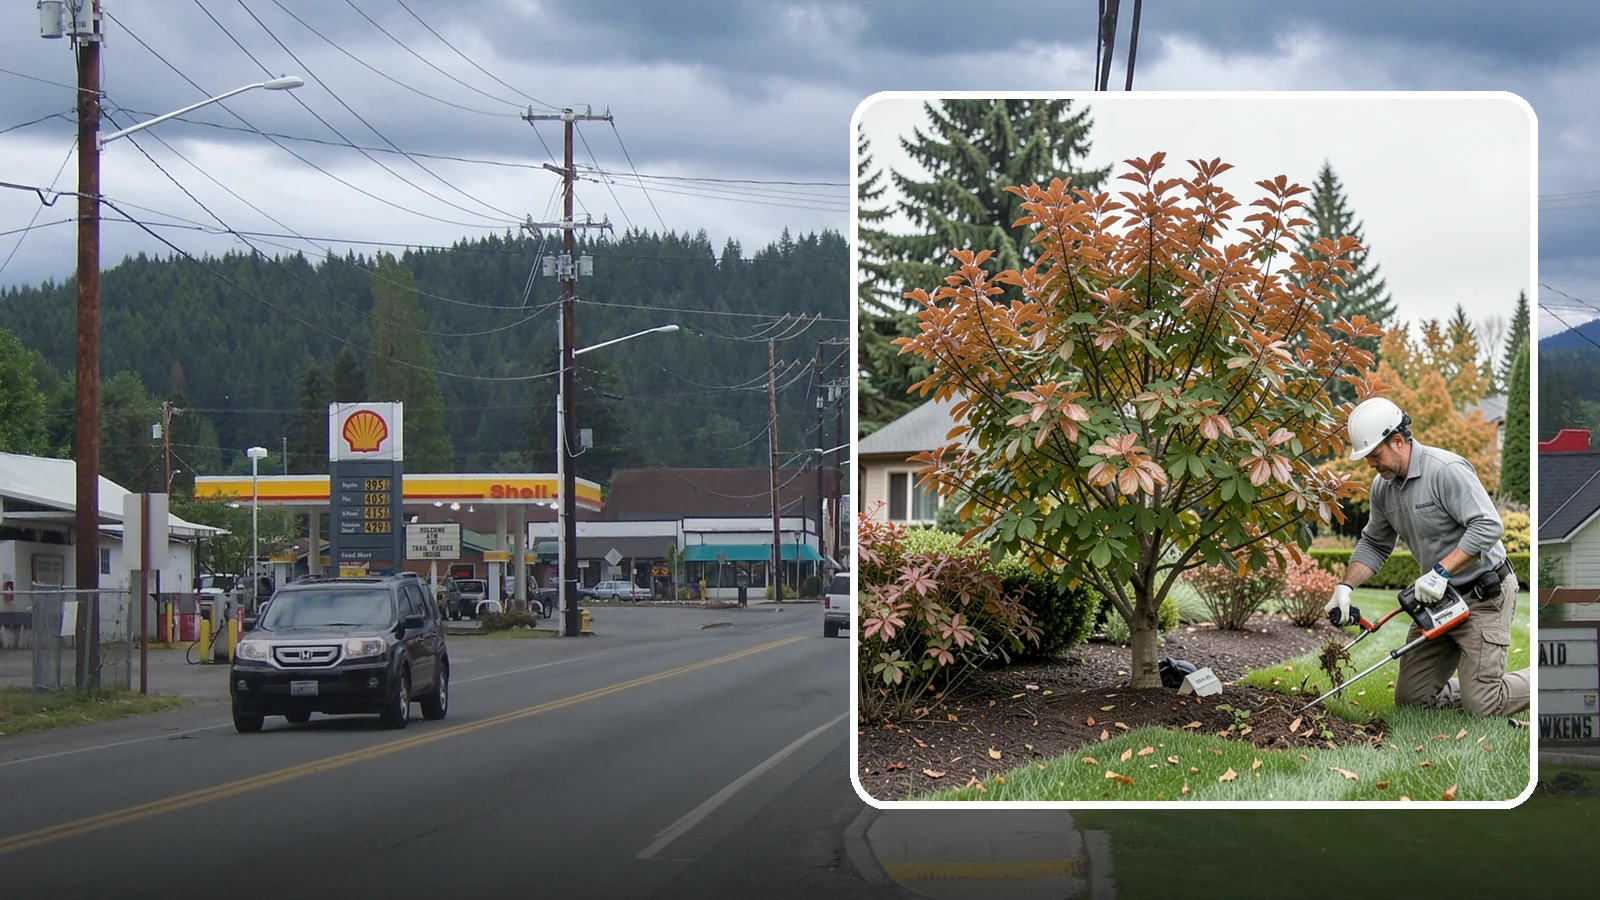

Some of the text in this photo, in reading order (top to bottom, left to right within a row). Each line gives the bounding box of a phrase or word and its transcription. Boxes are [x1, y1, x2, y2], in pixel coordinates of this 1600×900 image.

[366, 480, 384, 490] 395
[490, 484, 547, 499] Shell
[366, 494, 384, 504] 405
[366, 508, 384, 518] 415
[366, 522, 384, 532] 429
